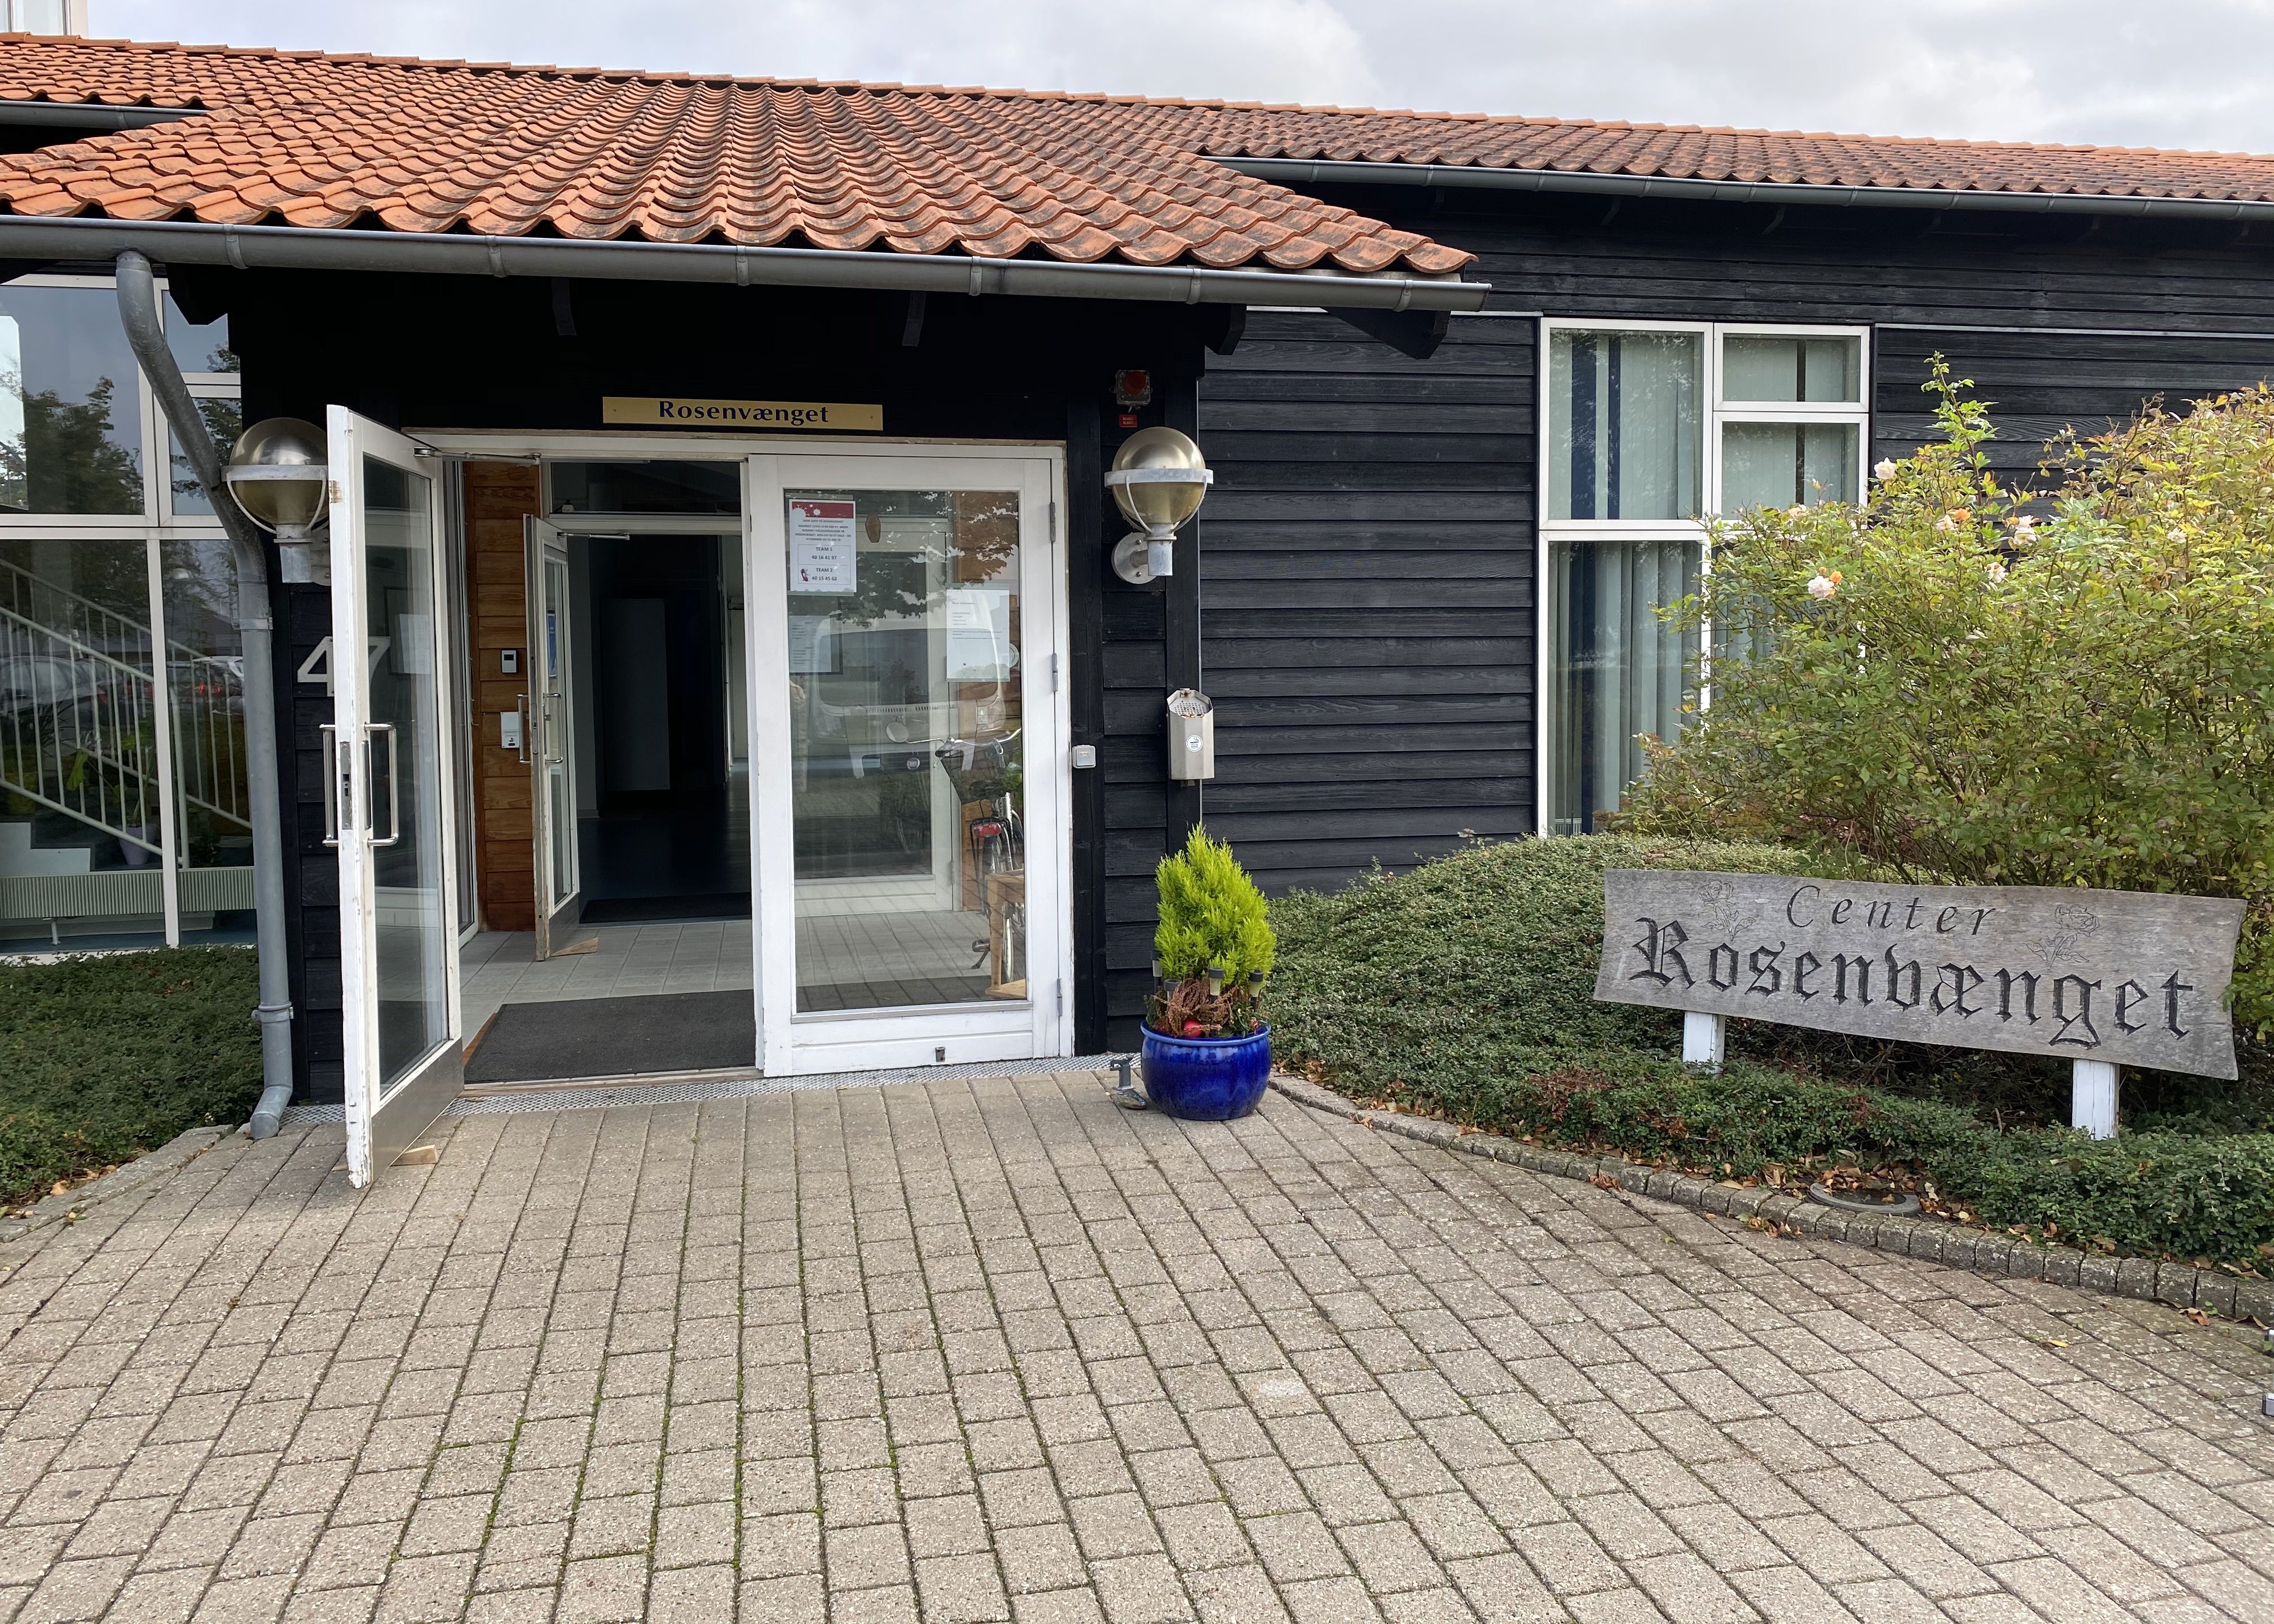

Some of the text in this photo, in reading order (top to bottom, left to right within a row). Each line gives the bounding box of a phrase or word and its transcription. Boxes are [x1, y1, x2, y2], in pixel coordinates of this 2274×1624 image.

[659, 400, 828, 426] Rosenvænget
[1786, 885, 1997, 936] Center
[1628, 916, 2193, 1051] Rosenvænget
